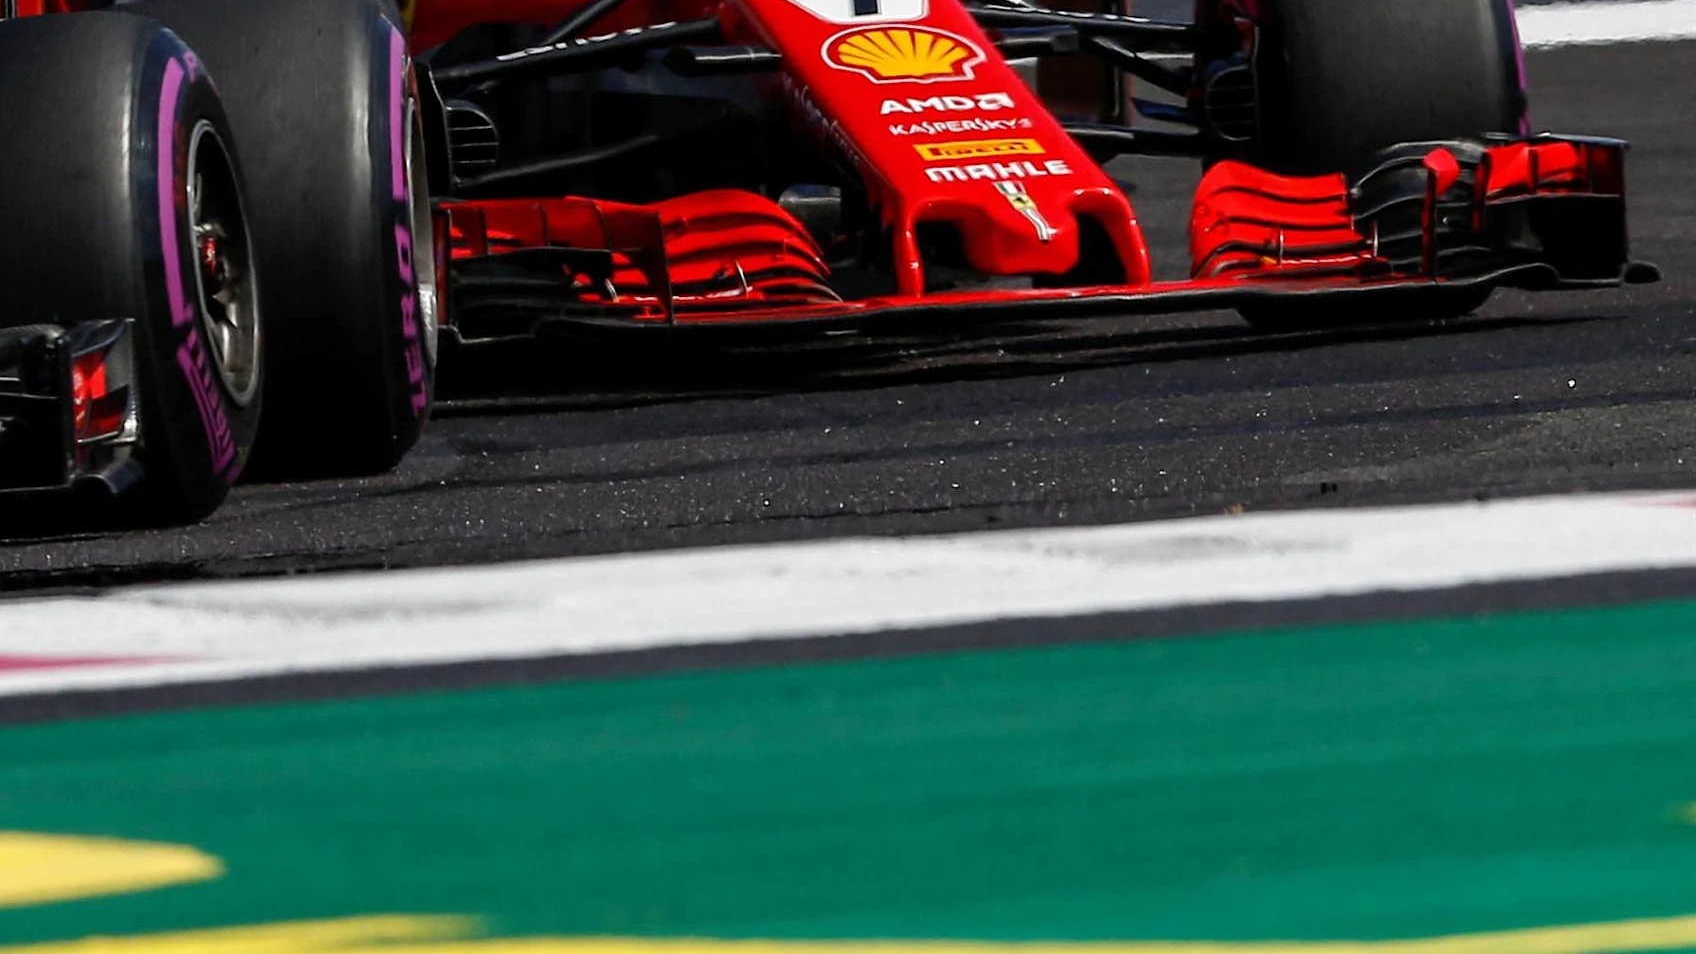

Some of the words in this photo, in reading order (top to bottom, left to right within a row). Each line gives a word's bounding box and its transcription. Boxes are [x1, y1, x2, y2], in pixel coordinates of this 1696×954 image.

[880, 96, 975, 115] AMD
[888, 117, 1017, 136] KASPERSKY
[924, 159, 1074, 183] MAHLE
